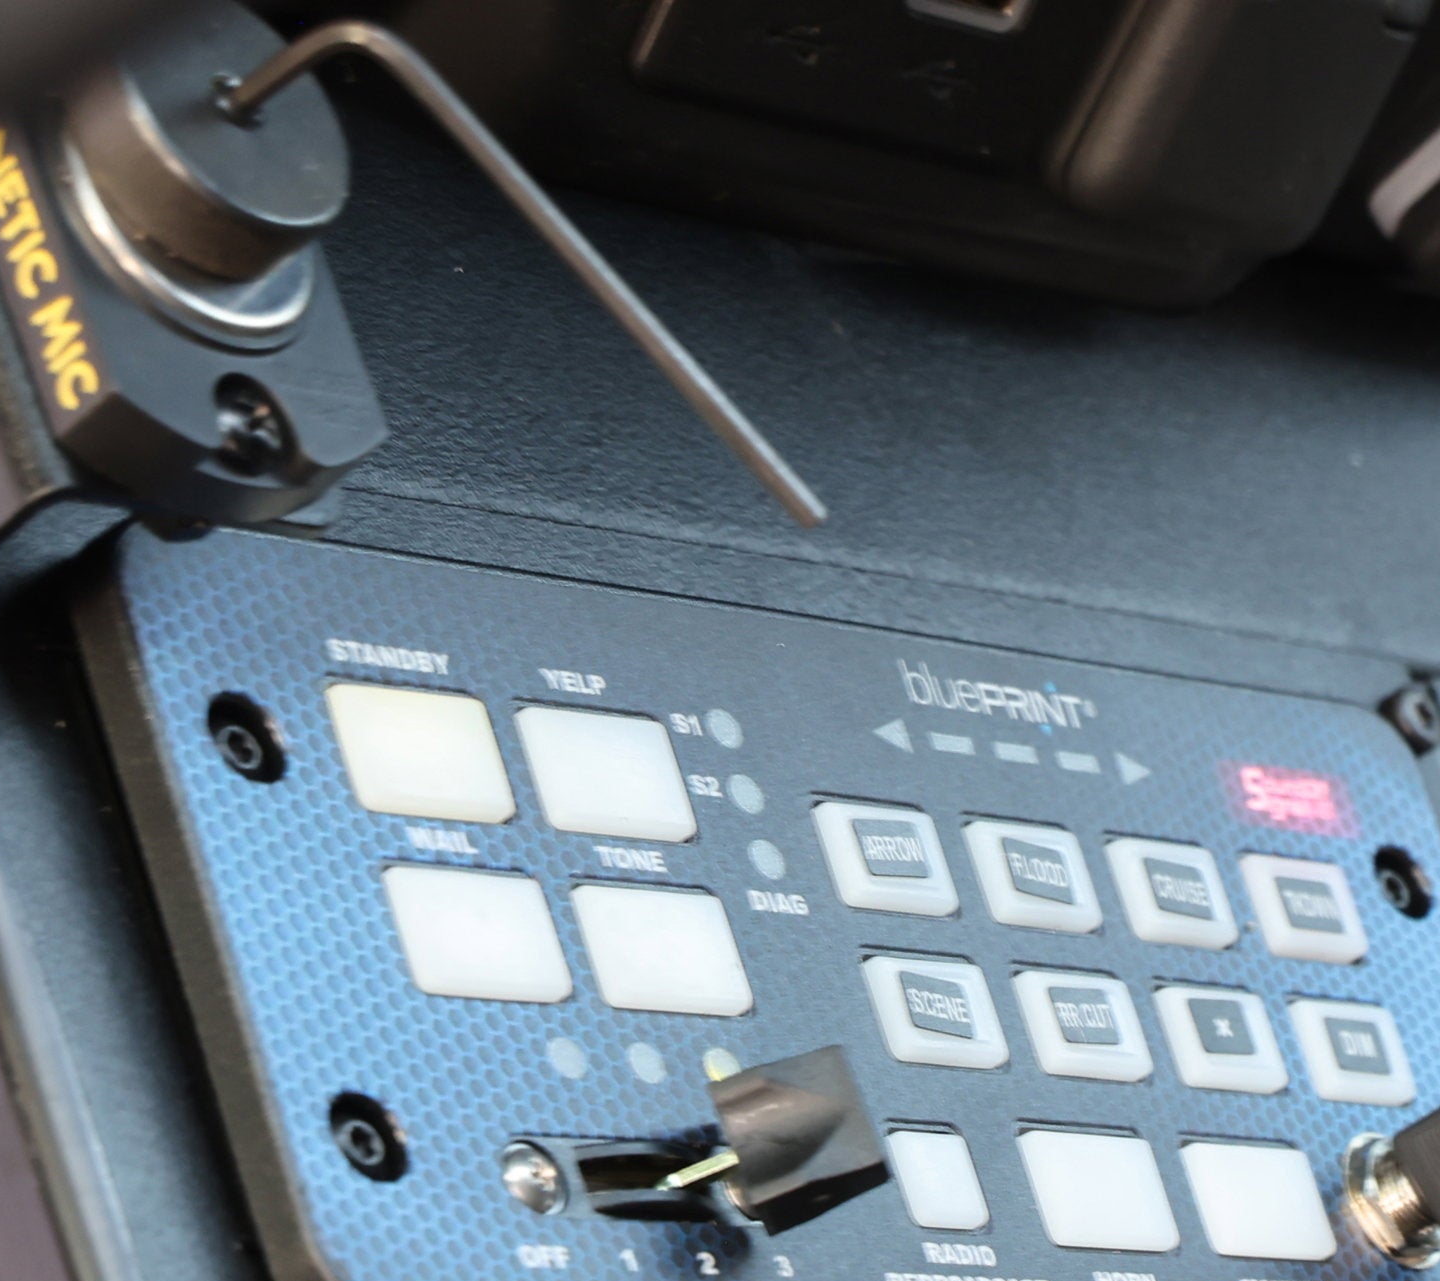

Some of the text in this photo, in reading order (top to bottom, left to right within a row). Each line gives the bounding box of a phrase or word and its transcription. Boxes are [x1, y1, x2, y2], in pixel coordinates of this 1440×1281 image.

[29, 295, 100, 411] MIC
[325, 637, 449, 675] STANDBY
[538, 667, 607, 696] YELP
[667, 712, 703, 737] S1
[686, 774, 723, 798] S2
[405, 825, 479, 855] WAIL
[862, 834, 925, 864] ARROW
[593, 845, 669, 873] TONE
[1010, 850, 1071, 890] FLOOD
[746, 889, 810, 916] DIAG
[1154, 873, 1210, 907] CRUISE
[907, 987, 972, 1024] SCENE
[619, 1248, 640, 1272] 1
[695, 1250, 720, 1275] 2
[772, 1254, 795, 1278] 3
[921, 1240, 997, 1267] RADIO
